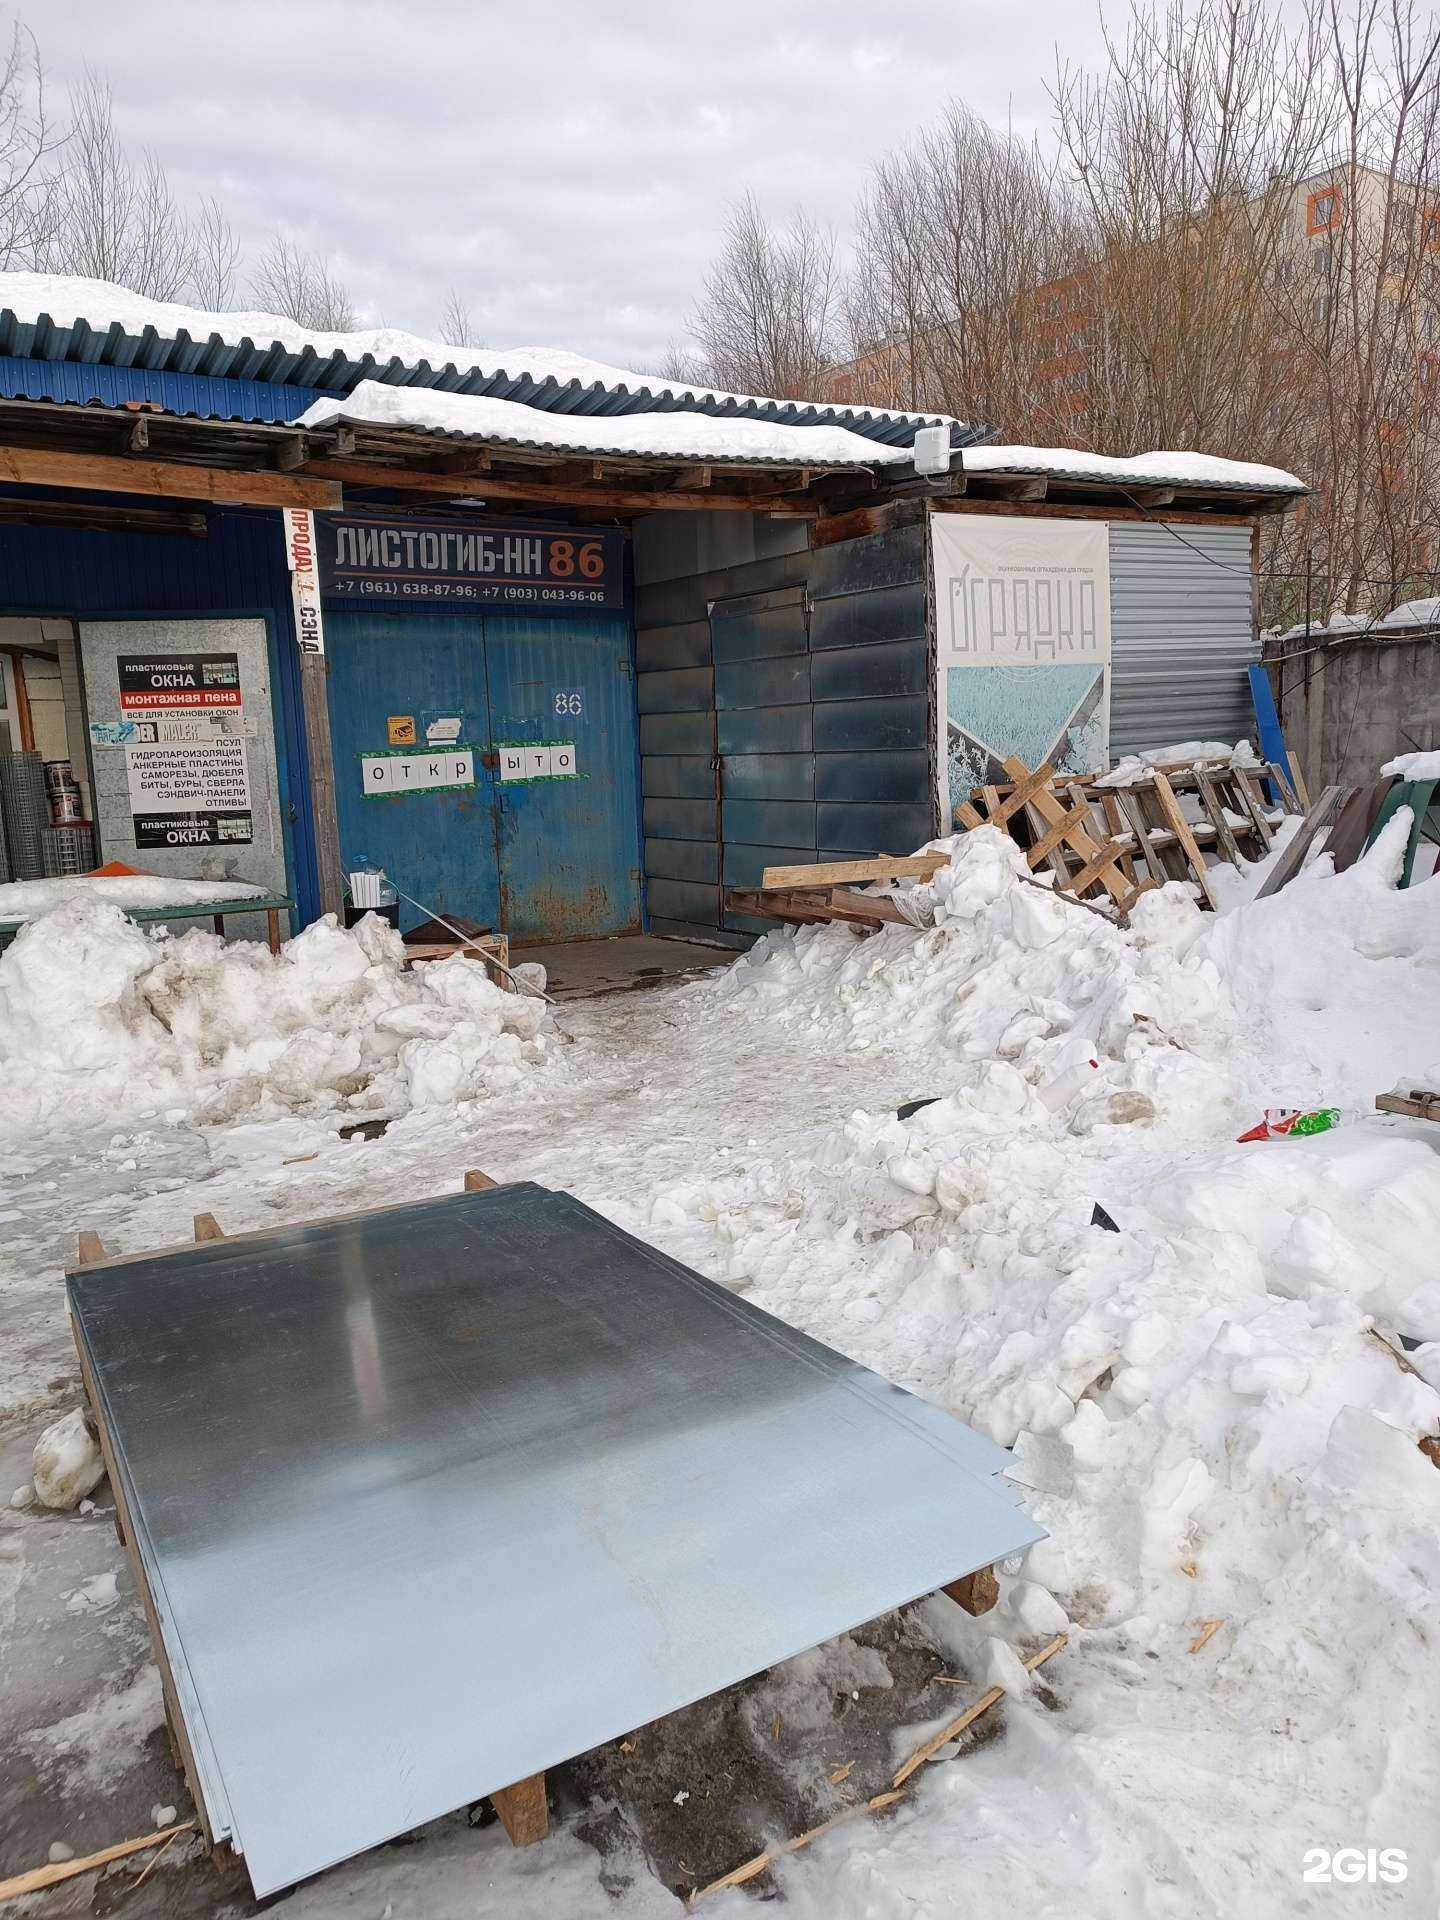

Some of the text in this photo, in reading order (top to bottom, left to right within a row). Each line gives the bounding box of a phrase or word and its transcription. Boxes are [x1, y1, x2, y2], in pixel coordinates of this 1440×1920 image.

[335, 527, 605, 578] ЛИСТОГИБ-НН 86
[335, 581, 605, 602] +7 (961) 638-87-96; +7 (903) 043-96-06
[949, 564, 1096, 660] ОГРЯДКА
[125, 663, 194, 672] пластиковые
[151, 674, 196, 688] ОКНА
[124, 692, 237, 705] монтажная пена
[555, 693, 583, 715] 86
[127, 708, 239, 719] ВСЕ ДЛЯ УСТАНОВКИ ОКОН
[216, 738, 242, 747] ПСУЛ
[130, 749, 243, 761] ГИДРОПАРОИЗОЛЯЦИЯ
[133, 759, 243, 770] АНКЕРНЫЕ ПЛАСТИНЫ
[141, 768, 245, 779] САМОРЕЗЫ, ДЮБЕЛЯ
[141, 779, 245, 790] БИТЫ, БУРЫ, СВЕРЛА
[157, 789, 246, 799] СЭНДВИЧ-ПАНЕЛИ
[205, 799, 247, 808] ОТЛИВЫ
[141, 820, 209, 830] пластиковые
[166, 831, 212, 844] ОКНА
